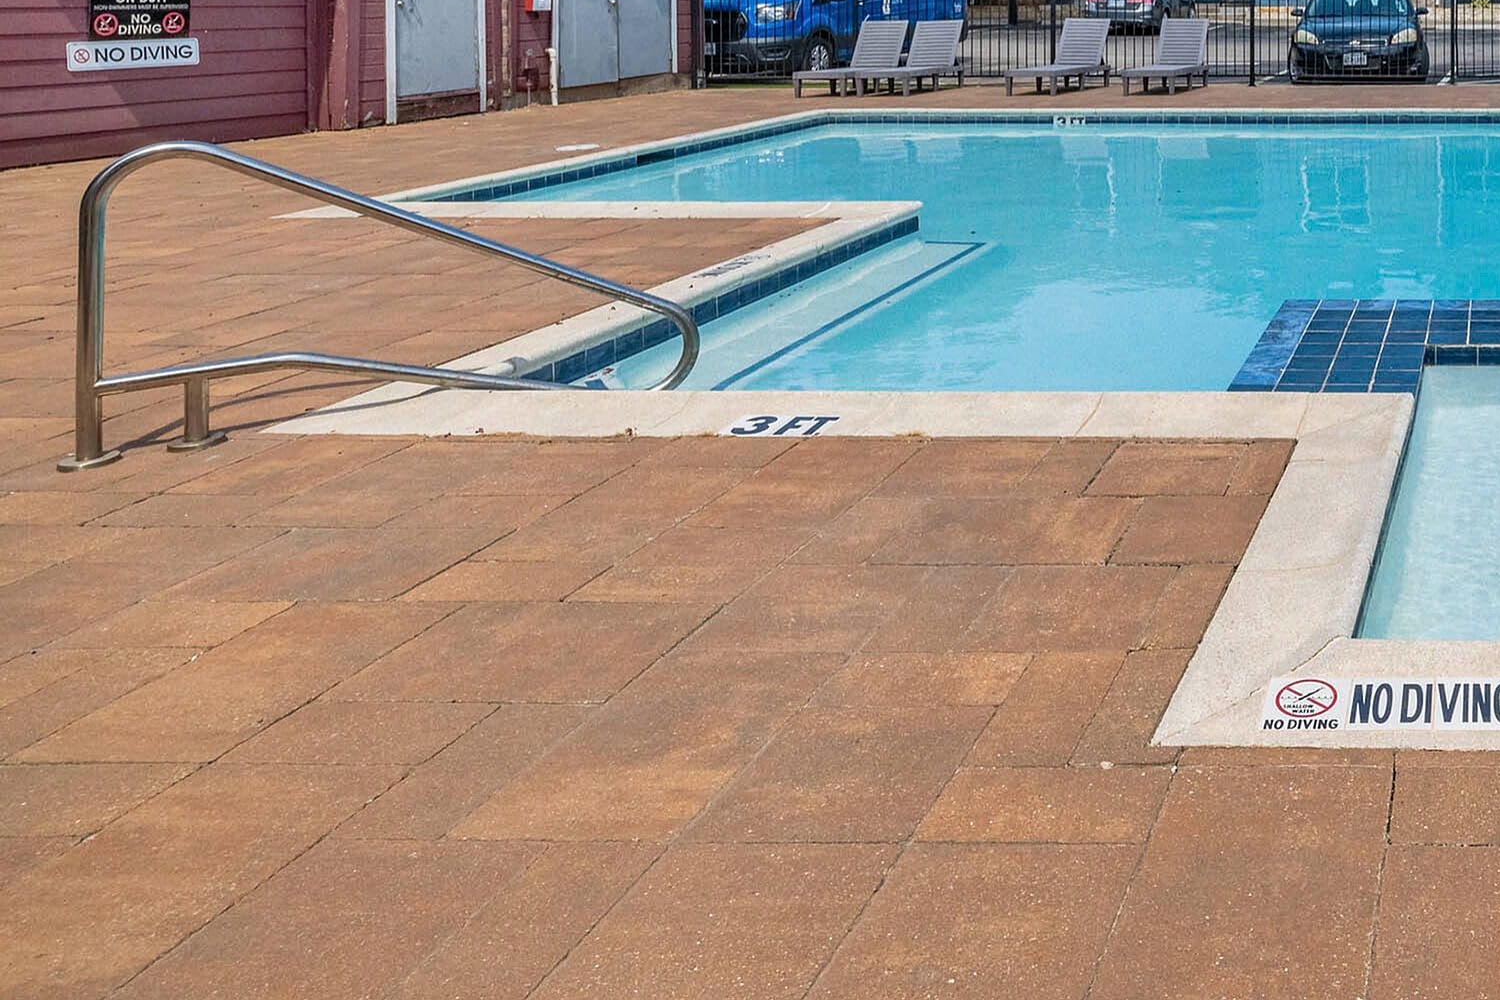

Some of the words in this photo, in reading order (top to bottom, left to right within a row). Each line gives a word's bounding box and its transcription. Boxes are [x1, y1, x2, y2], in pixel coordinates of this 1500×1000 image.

[131, 14, 151, 23] NO
[118, 24, 162, 35] DIVING
[95, 48, 124, 62] NO
[131, 45, 193, 61] DIVING
[730, 416, 778, 435] 3
[1348, 683, 1394, 724] NO
[1263, 719, 1285, 730] NO
[1286, 719, 1339, 730] DIVING
